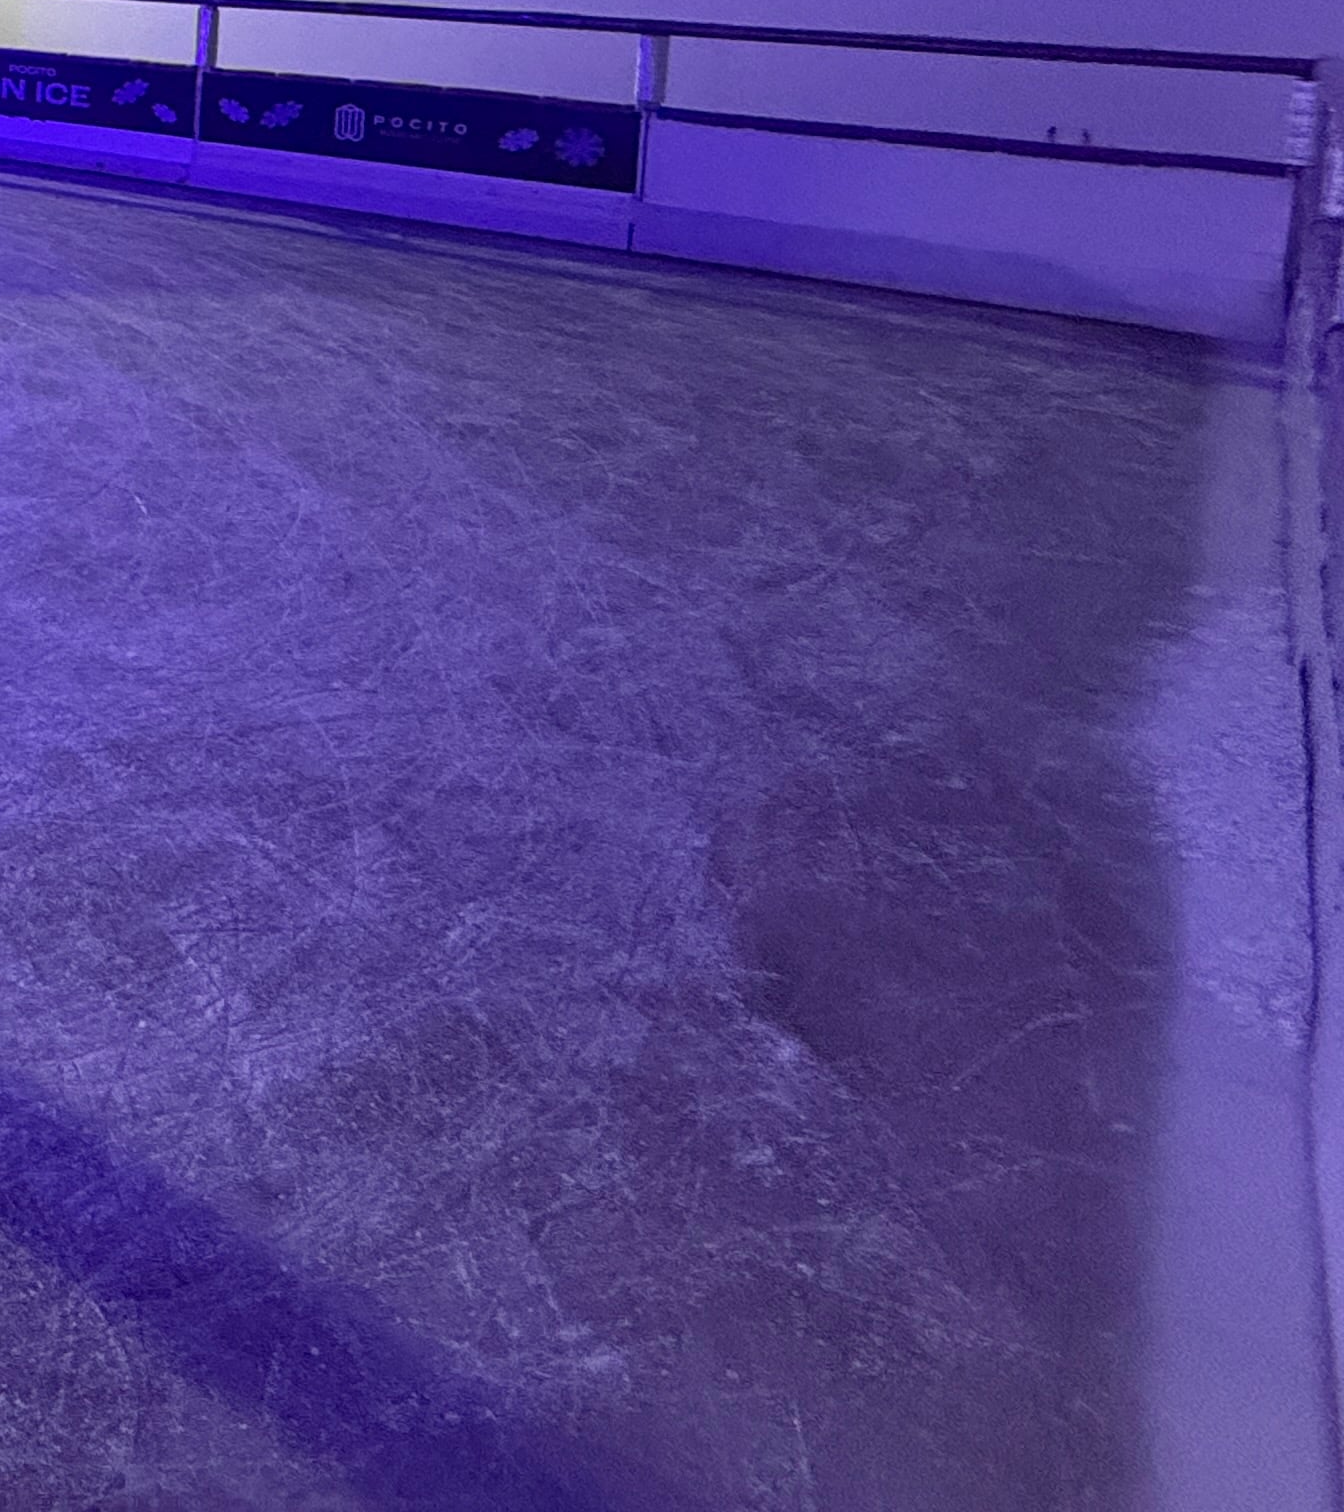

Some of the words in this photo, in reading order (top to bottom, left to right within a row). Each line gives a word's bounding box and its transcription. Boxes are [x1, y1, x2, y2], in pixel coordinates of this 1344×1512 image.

[9, 64, 57, 77] POCITO
[35, 80, 91, 109] ICE
[373, 114, 468, 136] POCITO
